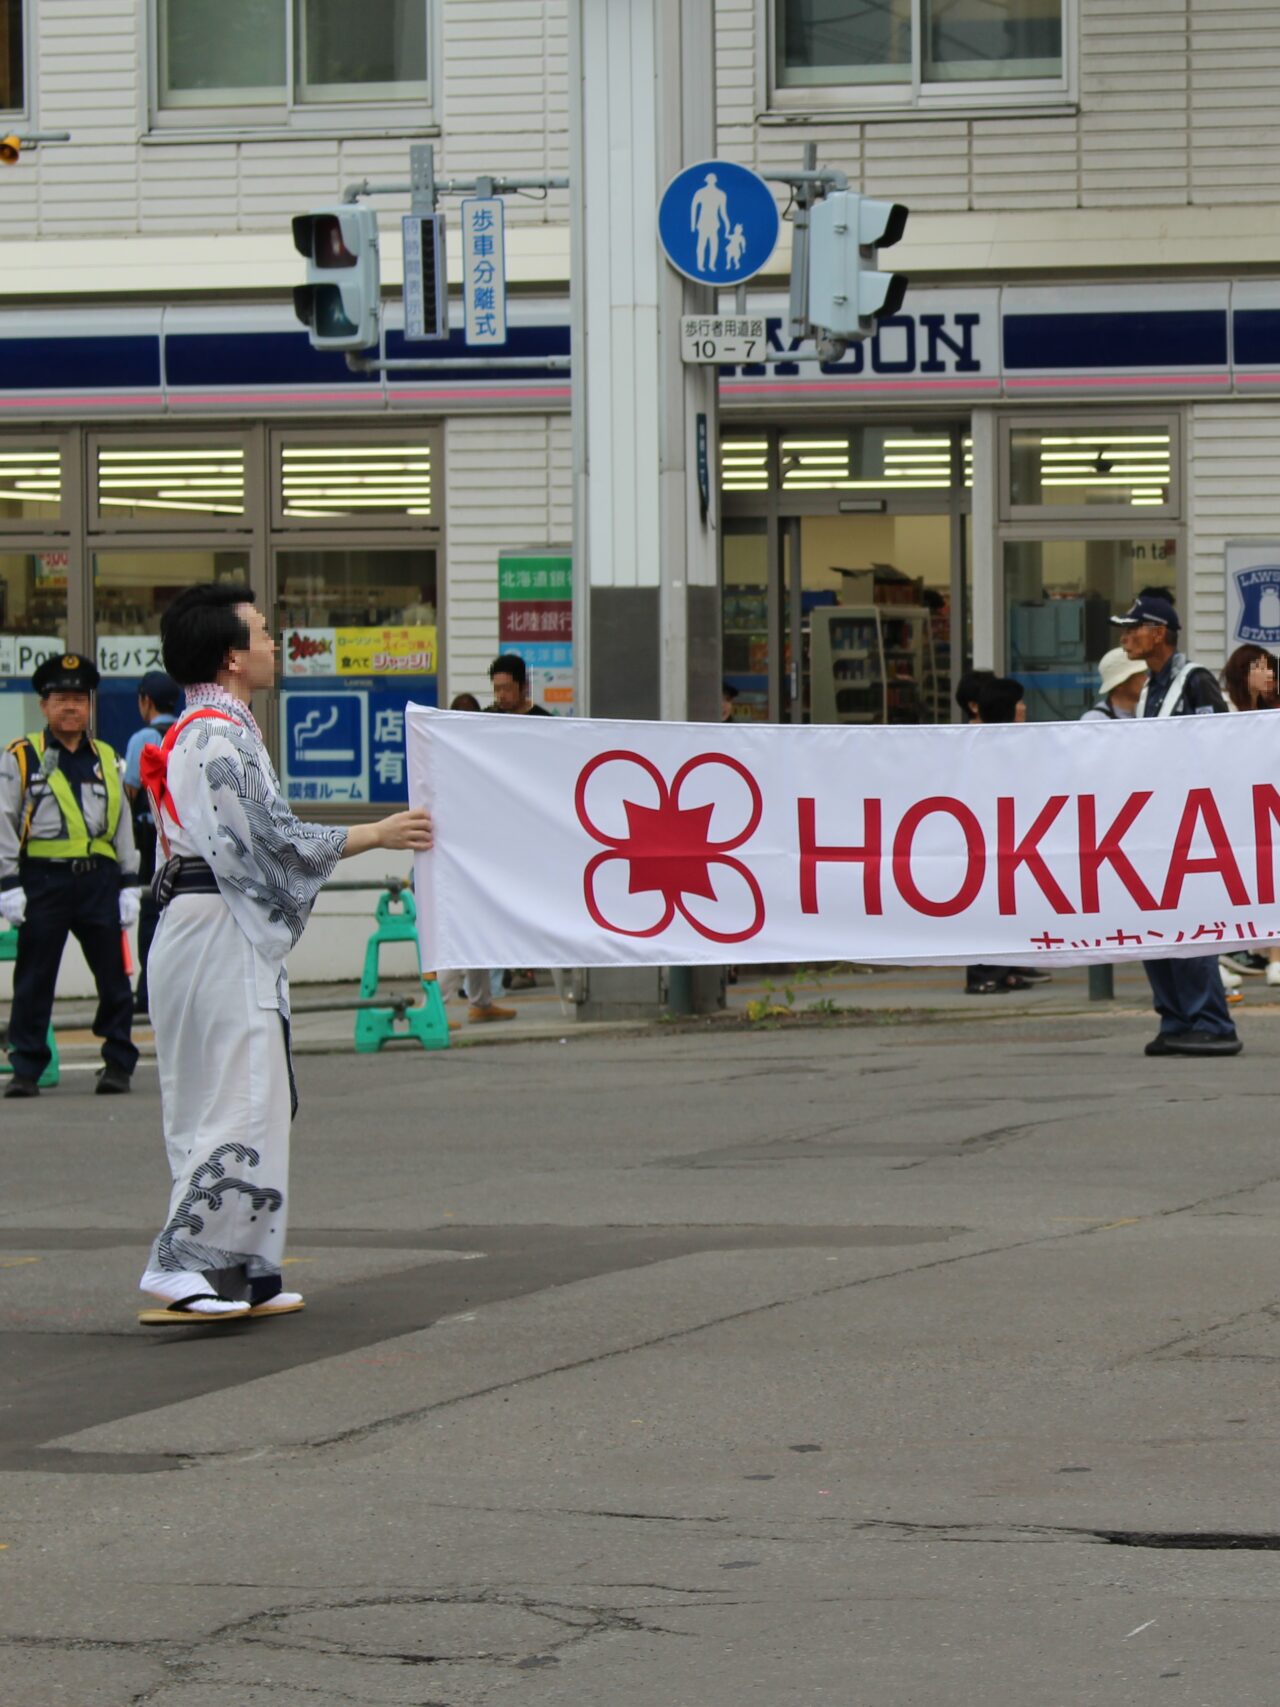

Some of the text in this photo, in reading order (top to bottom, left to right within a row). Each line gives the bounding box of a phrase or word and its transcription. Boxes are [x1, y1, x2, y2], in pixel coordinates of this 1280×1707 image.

[471, 208, 498, 337] 歩車分離式
[685, 320, 763, 337] 歩行者用道路
[288, 782, 363, 800] 喫煙ルーム
